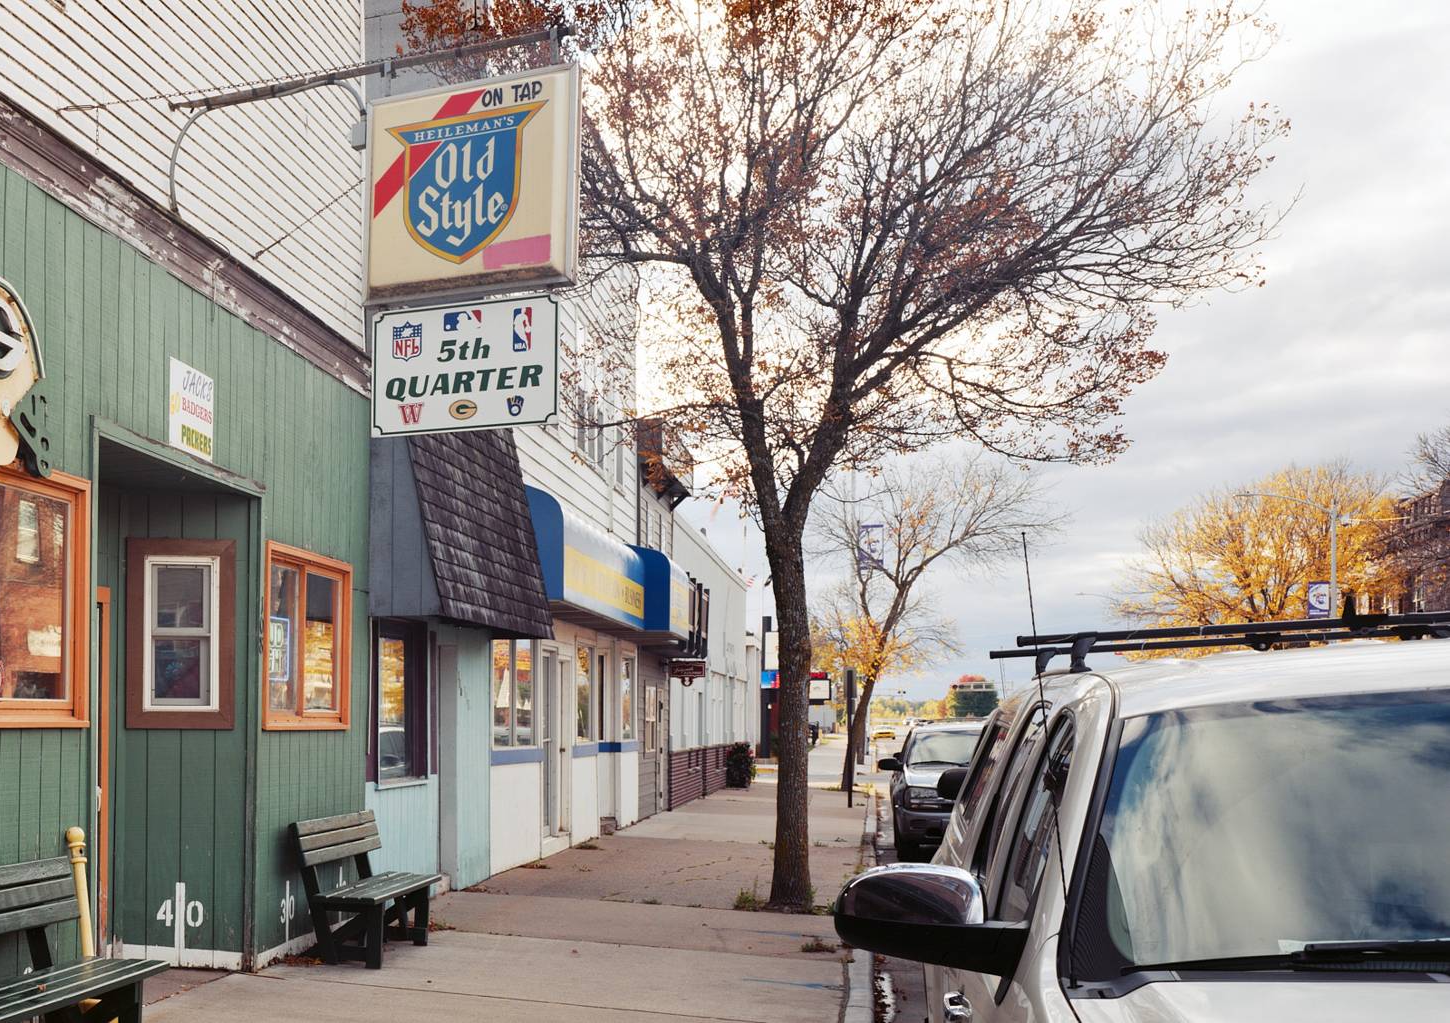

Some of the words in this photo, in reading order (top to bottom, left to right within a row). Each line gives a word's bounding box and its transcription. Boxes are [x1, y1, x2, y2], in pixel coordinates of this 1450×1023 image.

[481, 87, 503, 108] ON
[511, 80, 542, 103] TAP
[413, 115, 515, 142] HEILEMAN'S
[434, 136, 496, 190] Old
[394, 338, 420, 357] NFL
[437, 337, 491, 363] 5th
[514, 342, 527, 351] NBA
[385, 364, 543, 402] QUARTER
[181, 396, 213, 425] BADGERS
[398, 402, 424, 425] W
[181, 423, 212, 457] PACKERS
